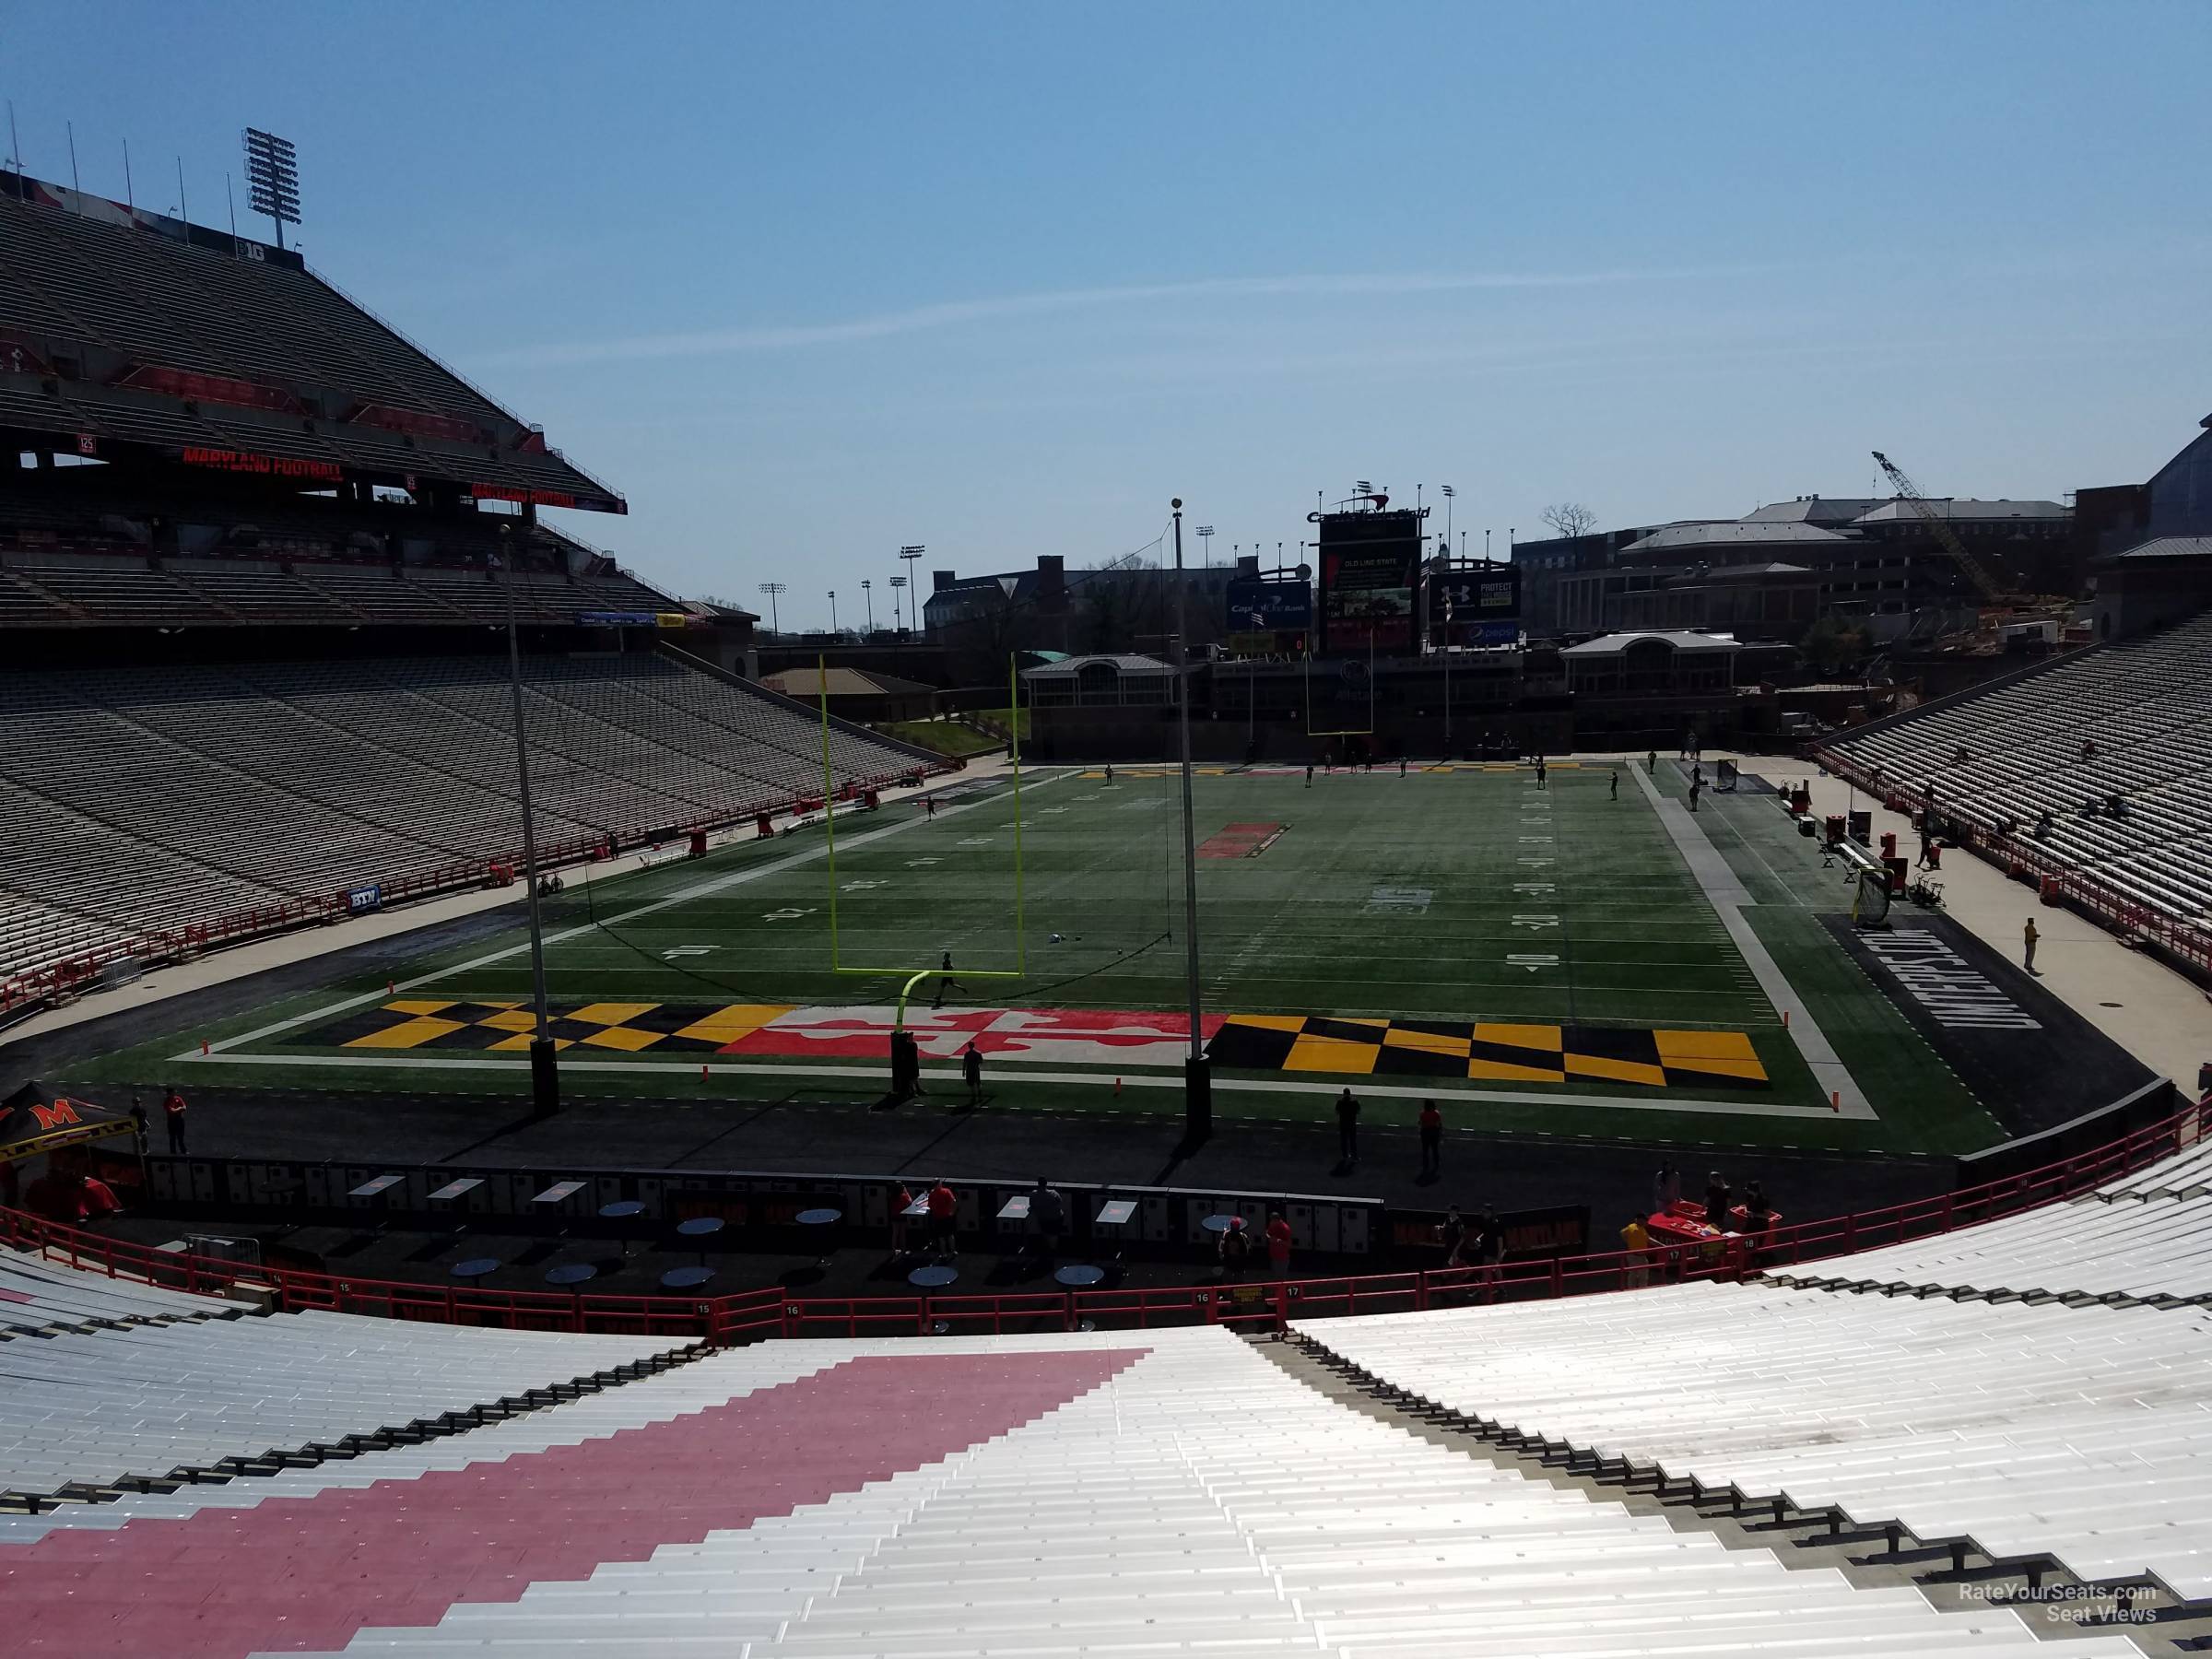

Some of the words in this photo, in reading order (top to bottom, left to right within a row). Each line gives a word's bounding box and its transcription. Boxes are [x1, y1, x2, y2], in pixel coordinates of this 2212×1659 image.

[182, 447, 270, 473] MARYLAND
[1376, 558, 1397, 566] STATE
[1481, 582, 1512, 592] PROTECT
[1231, 604, 1265, 613] Capil
[1284, 604, 1305, 612] Bank
[1486, 627, 1514, 642] pepsi
[351, 889, 376, 908] BTN
[28, 1100, 83, 1130] M
[1744, 1239, 1754, 1248] 18
[1670, 1251, 1680, 1260] 17
[339, 1284, 350, 1292] 15
[1288, 1288, 1299, 1297] 17
[1196, 1293, 1208, 1302] 16
[698, 1304, 710, 1313] 15
[786, 1306, 798, 1315] 16
